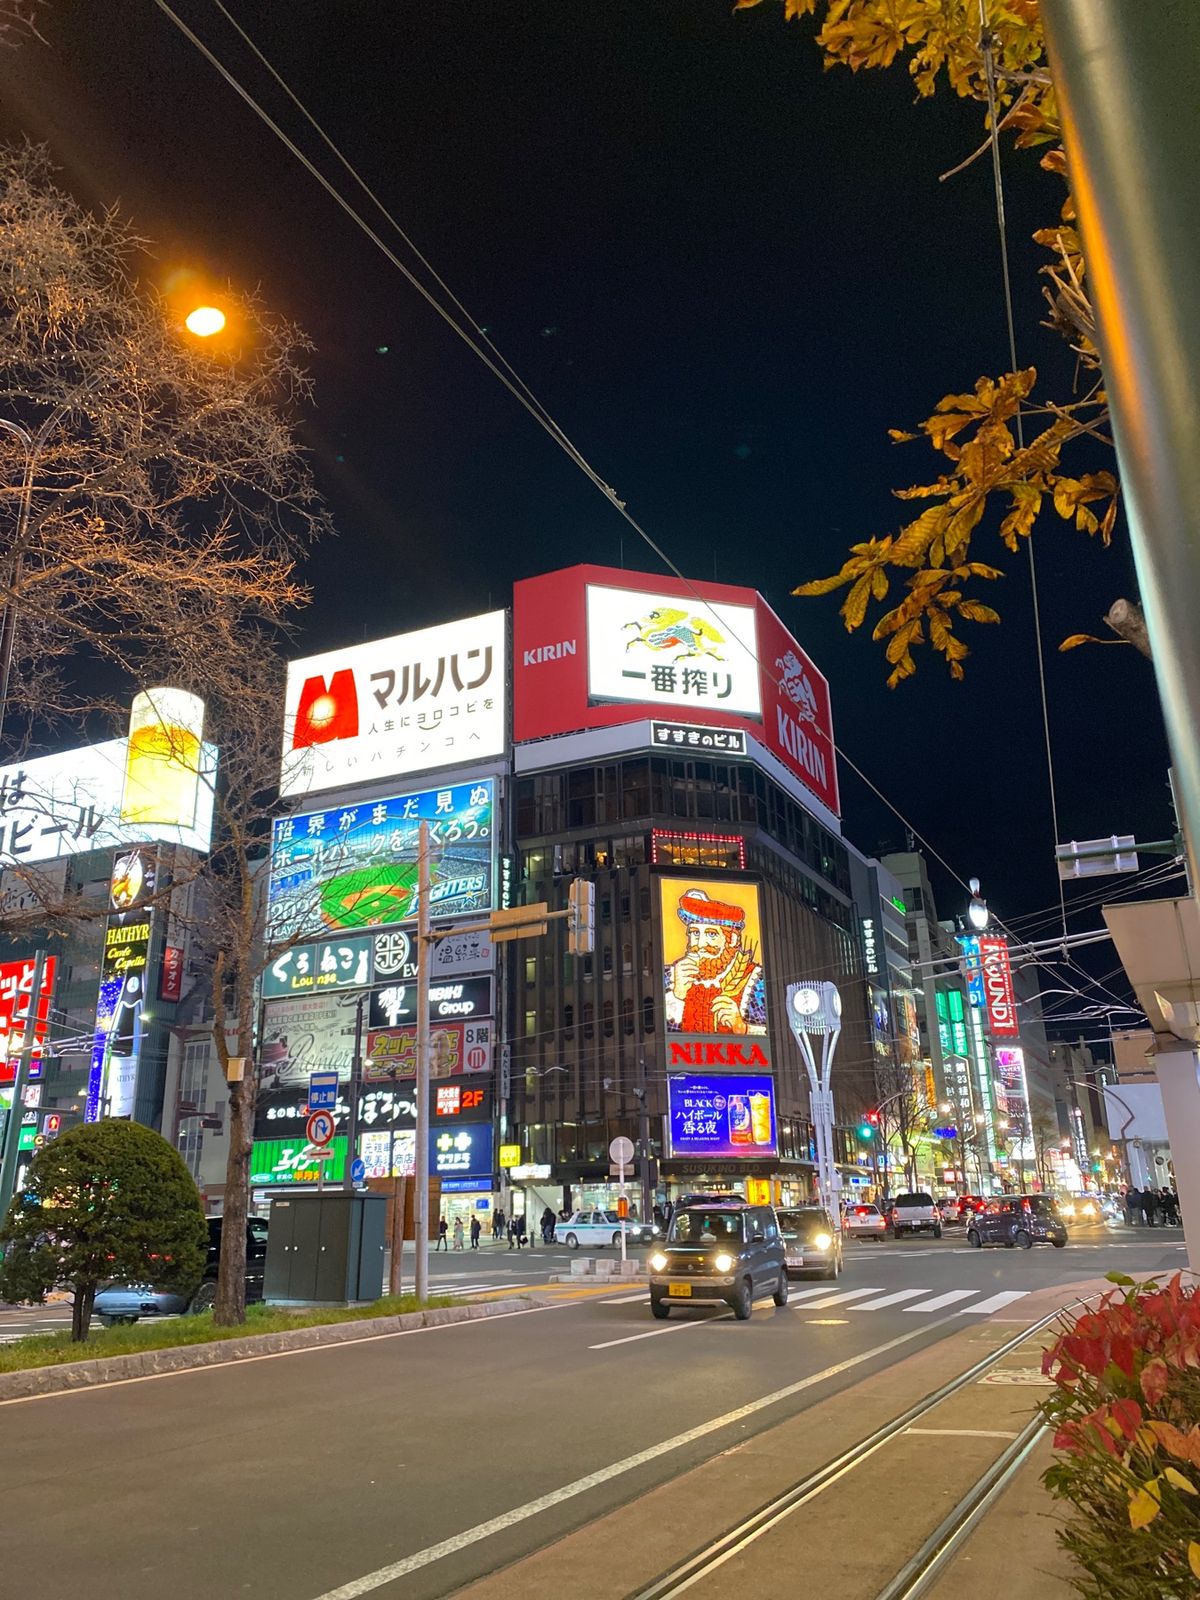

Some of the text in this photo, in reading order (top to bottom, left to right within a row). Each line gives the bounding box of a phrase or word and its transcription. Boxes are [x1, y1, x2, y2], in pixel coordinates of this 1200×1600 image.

[523, 639, 577, 666] KIRIN
[370, 645, 493, 710] マルハン
[621, 663, 733, 699] 一番搾り
[367, 698, 493, 735] 人生にヨロコビを
[656, 727, 741, 749] すすきのビル
[776, 704, 828, 791] KIRIN
[277, 786, 489, 842] 世界がまだ見ぬ
[0, 805, 105, 854] ビール
[107, 924, 150, 945] HATHYR
[272, 946, 353, 982] くろねこ
[403, 963, 419, 977] EV
[438, 1001, 474, 1015] Group
[465, 1028, 489, 1043] 8階
[669, 1042, 769, 1066] NIKKA
[462, 1090, 484, 1107] 2F
[684, 1098, 713, 1108] BLACK
[675, 1109, 722, 1121] ハイボール
[682, 1120, 717, 1134] 香る夜
